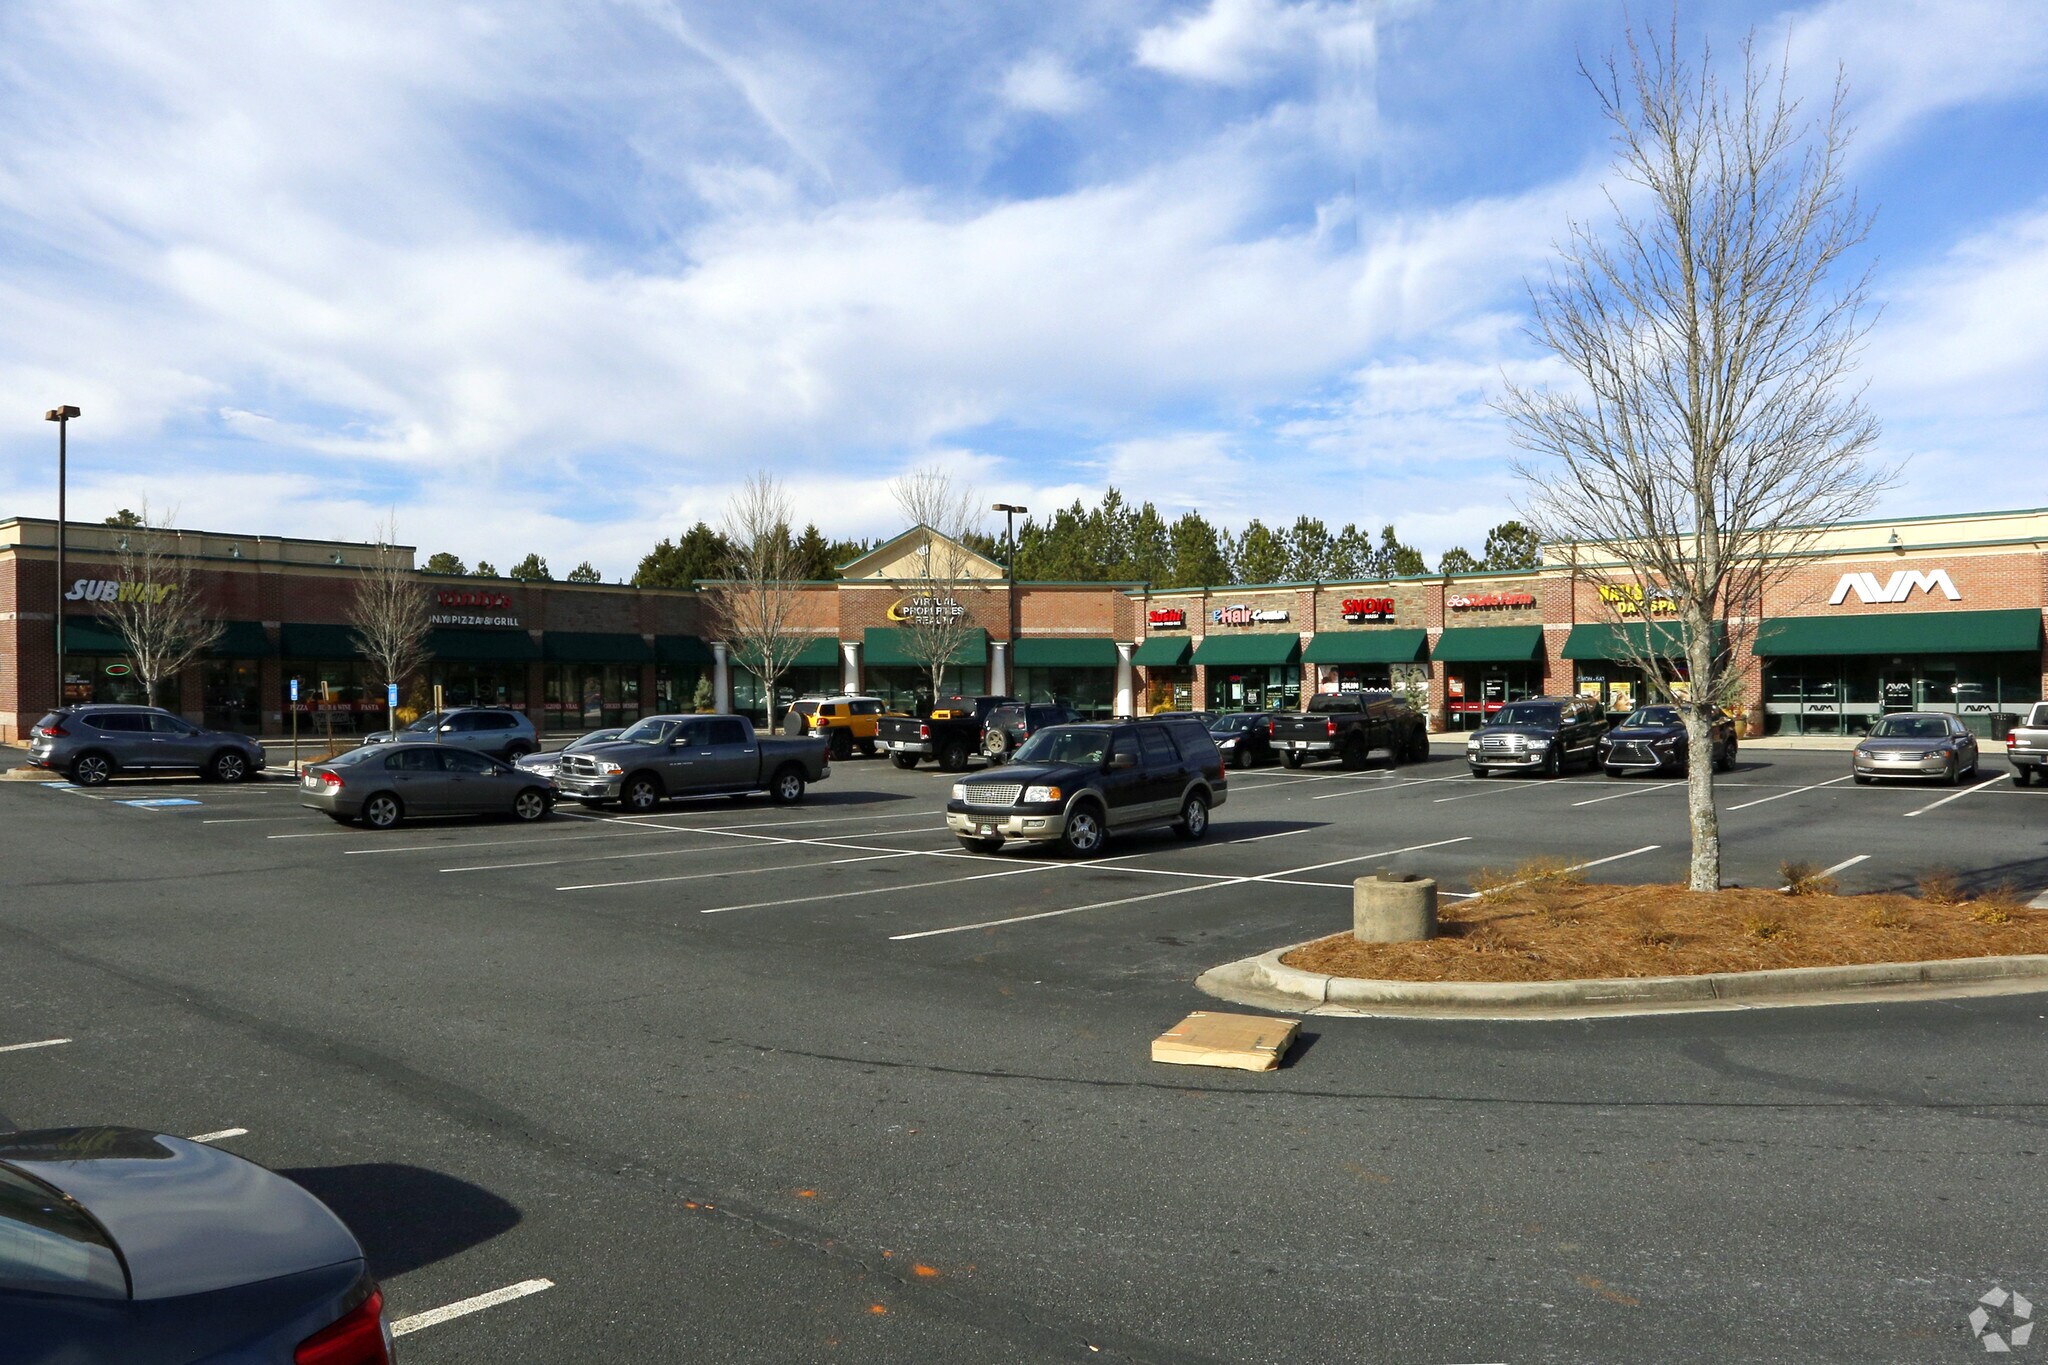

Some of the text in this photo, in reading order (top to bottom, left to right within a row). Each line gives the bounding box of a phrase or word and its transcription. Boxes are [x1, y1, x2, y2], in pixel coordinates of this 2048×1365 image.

[64, 579, 177, 604] SUBWAY
[1828, 569, 1962, 605] AVM
[903, 607, 965, 616] PROPRES
[1650, 601, 1677, 612] SPA
[451, 615, 480, 625] PIZZA
[483, 616, 491, 625] &
[494, 616, 519, 626] GRILL
[1149, 608, 1183, 622] Sushi
[1964, 704, 1993, 712] AVM
